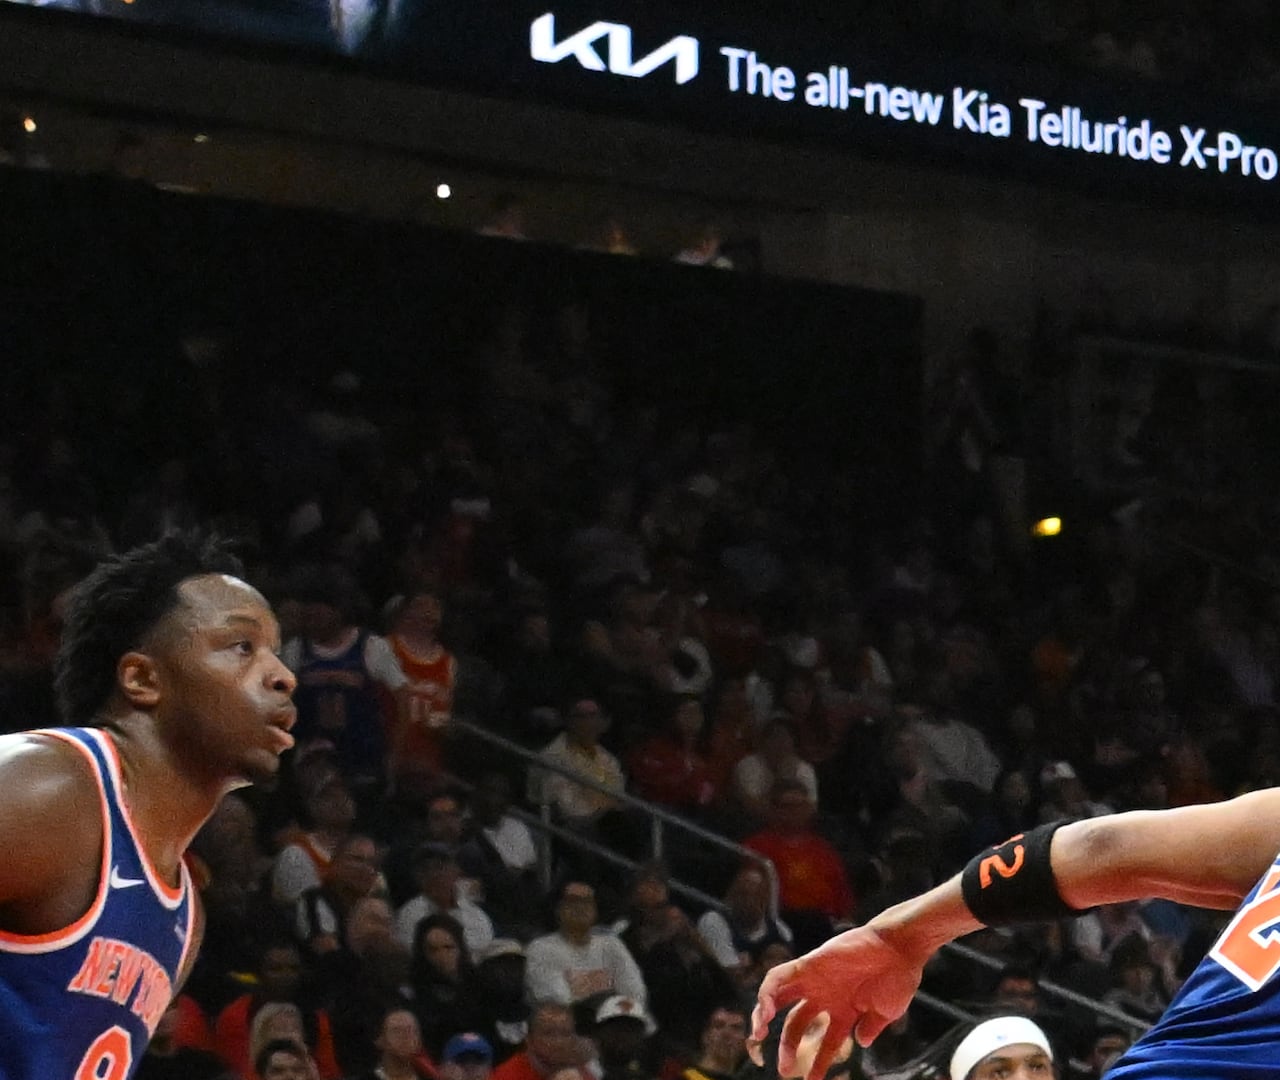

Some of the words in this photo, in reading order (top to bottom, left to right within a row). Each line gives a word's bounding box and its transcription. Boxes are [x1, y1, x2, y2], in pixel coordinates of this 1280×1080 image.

[530, 12, 699, 85] KIA
[720, 46, 795, 101] The
[805, 65, 943, 125] all-new
[952, 87, 1011, 137] Kia
[1018, 97, 1172, 164] Telluride
[1179, 124, 1279, 180] X-Pro
